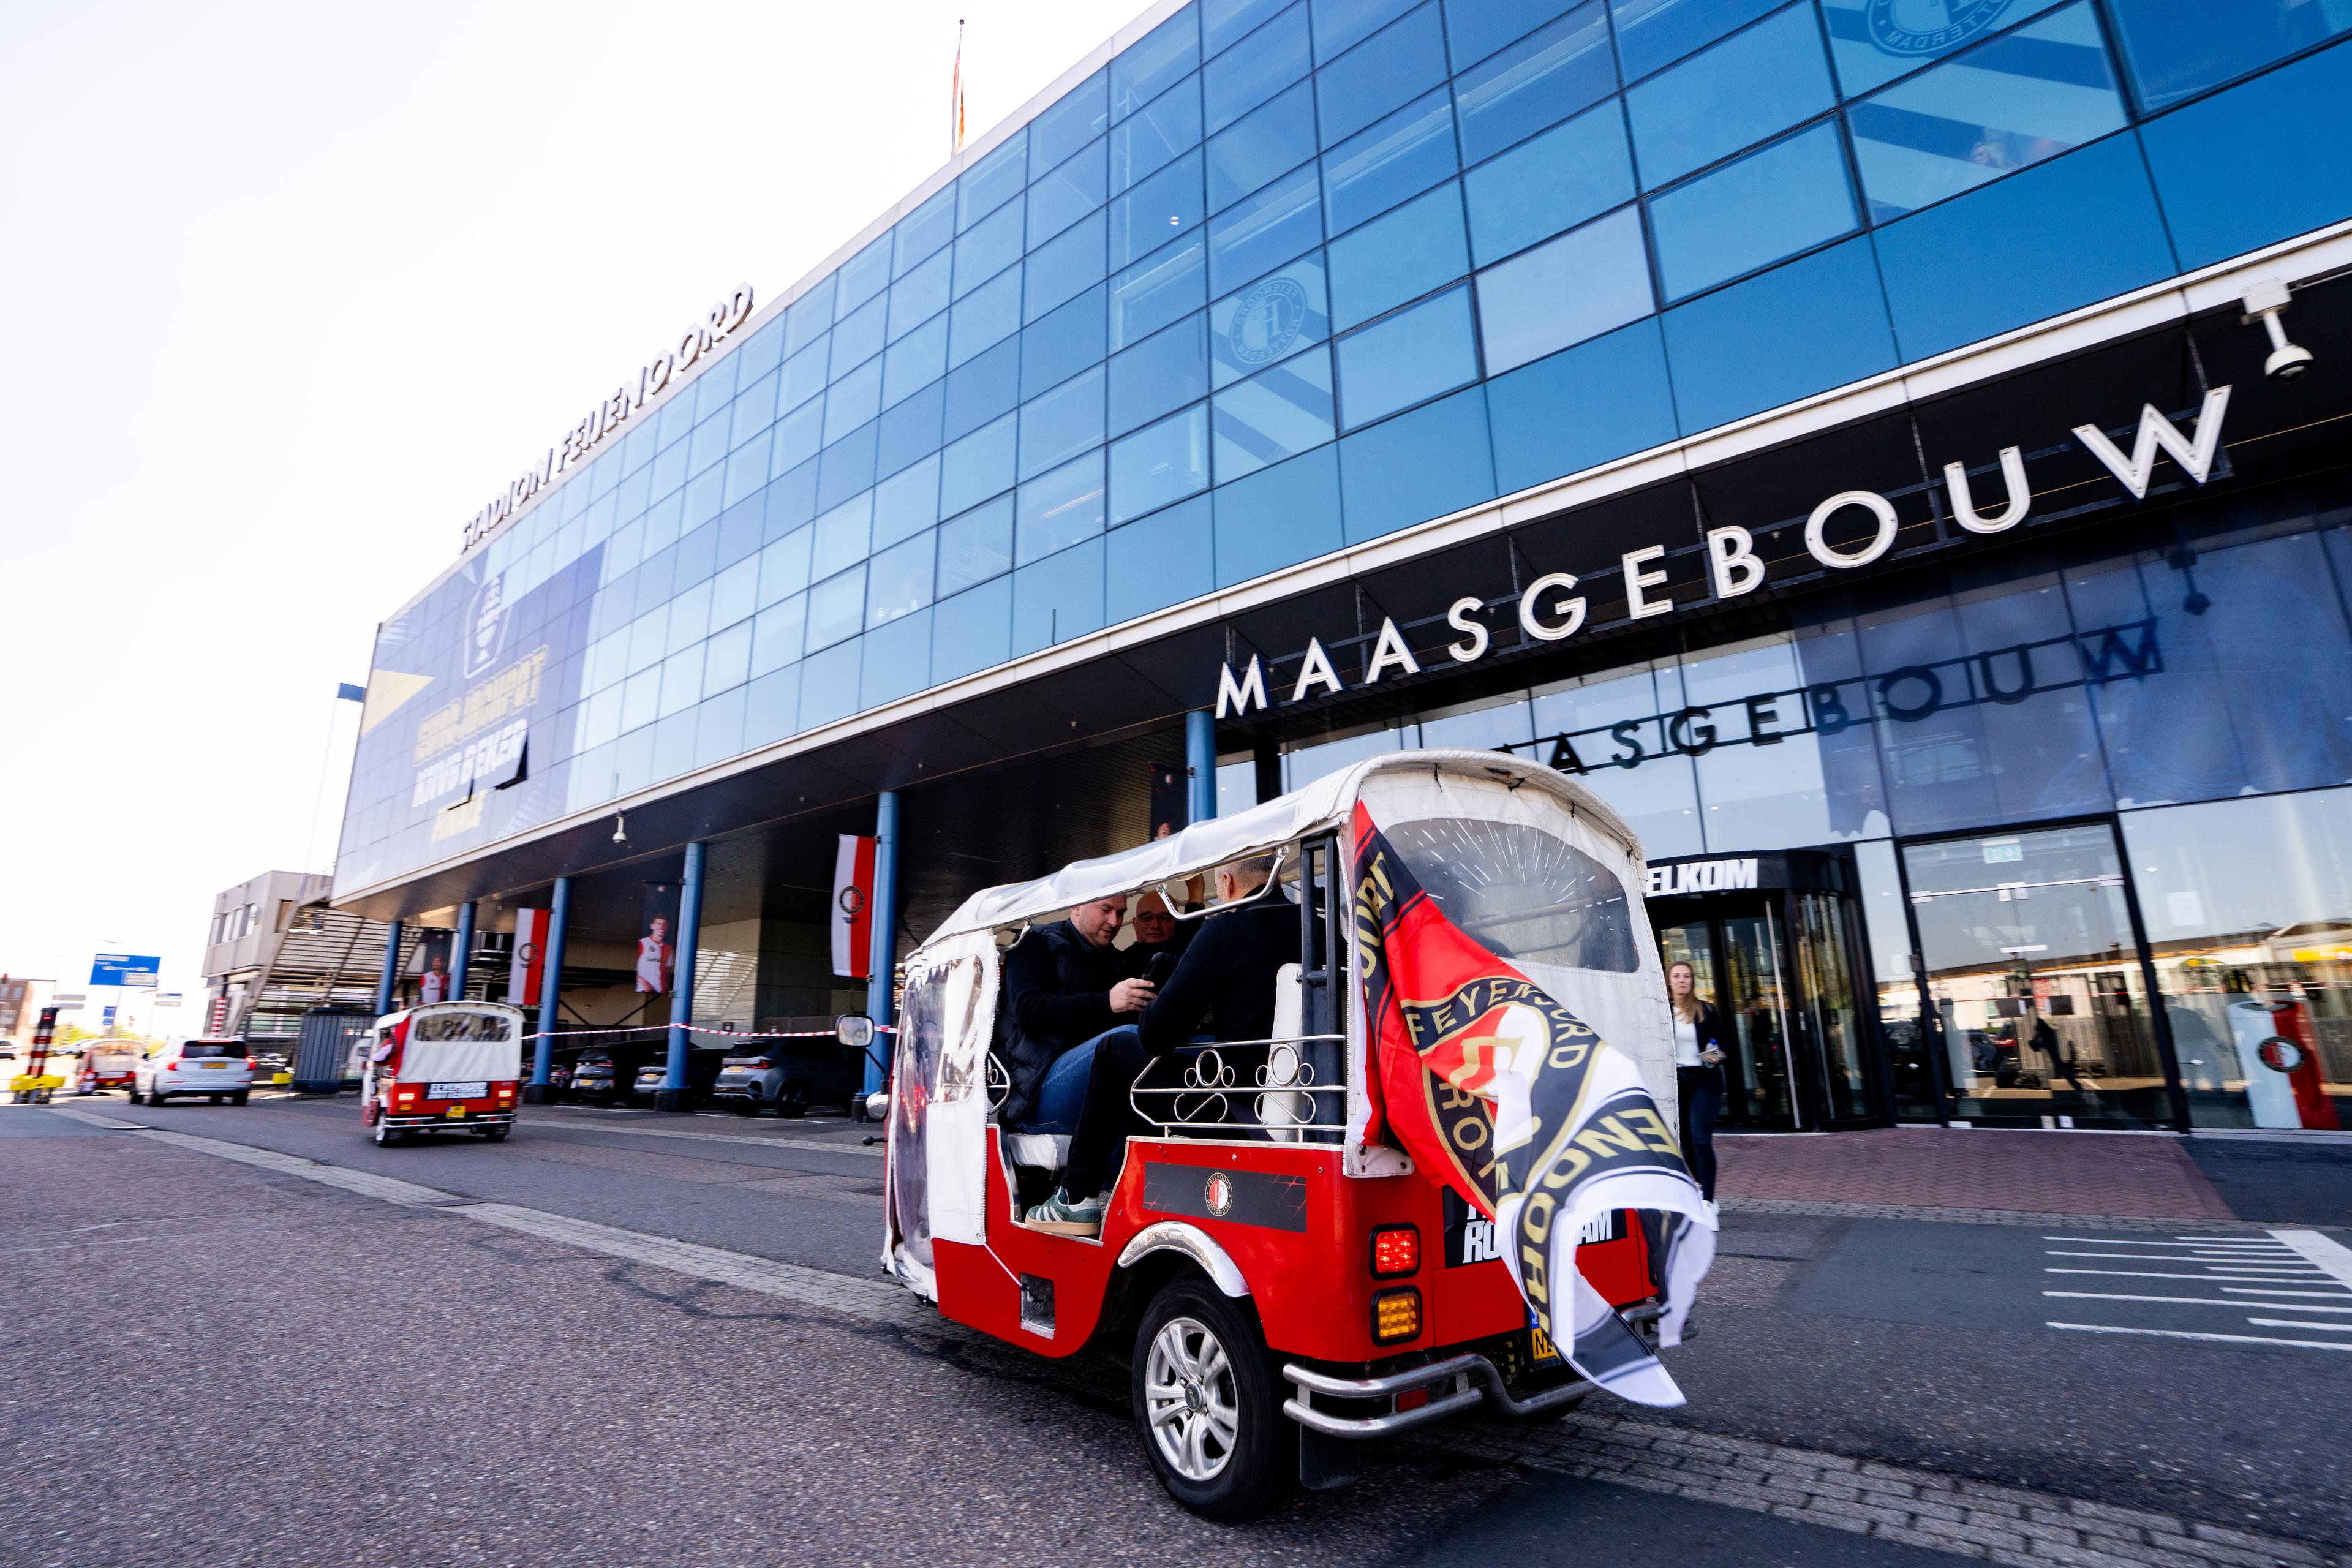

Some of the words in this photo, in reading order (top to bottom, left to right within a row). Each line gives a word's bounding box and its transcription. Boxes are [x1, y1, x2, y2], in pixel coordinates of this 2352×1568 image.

[460, 447, 554, 555] STADION
[557, 281, 754, 473] FEIJENOORD
[1215, 385, 2233, 719] MAASGEBOUW
[1544, 616, 2160, 775] ASGEBOUW
[1645, 858, 1758, 897] ELKOM
[1207, 1174, 1231, 1189] FEYENOORD
[1207, 1199, 1231, 1215] ROTTERDAM
